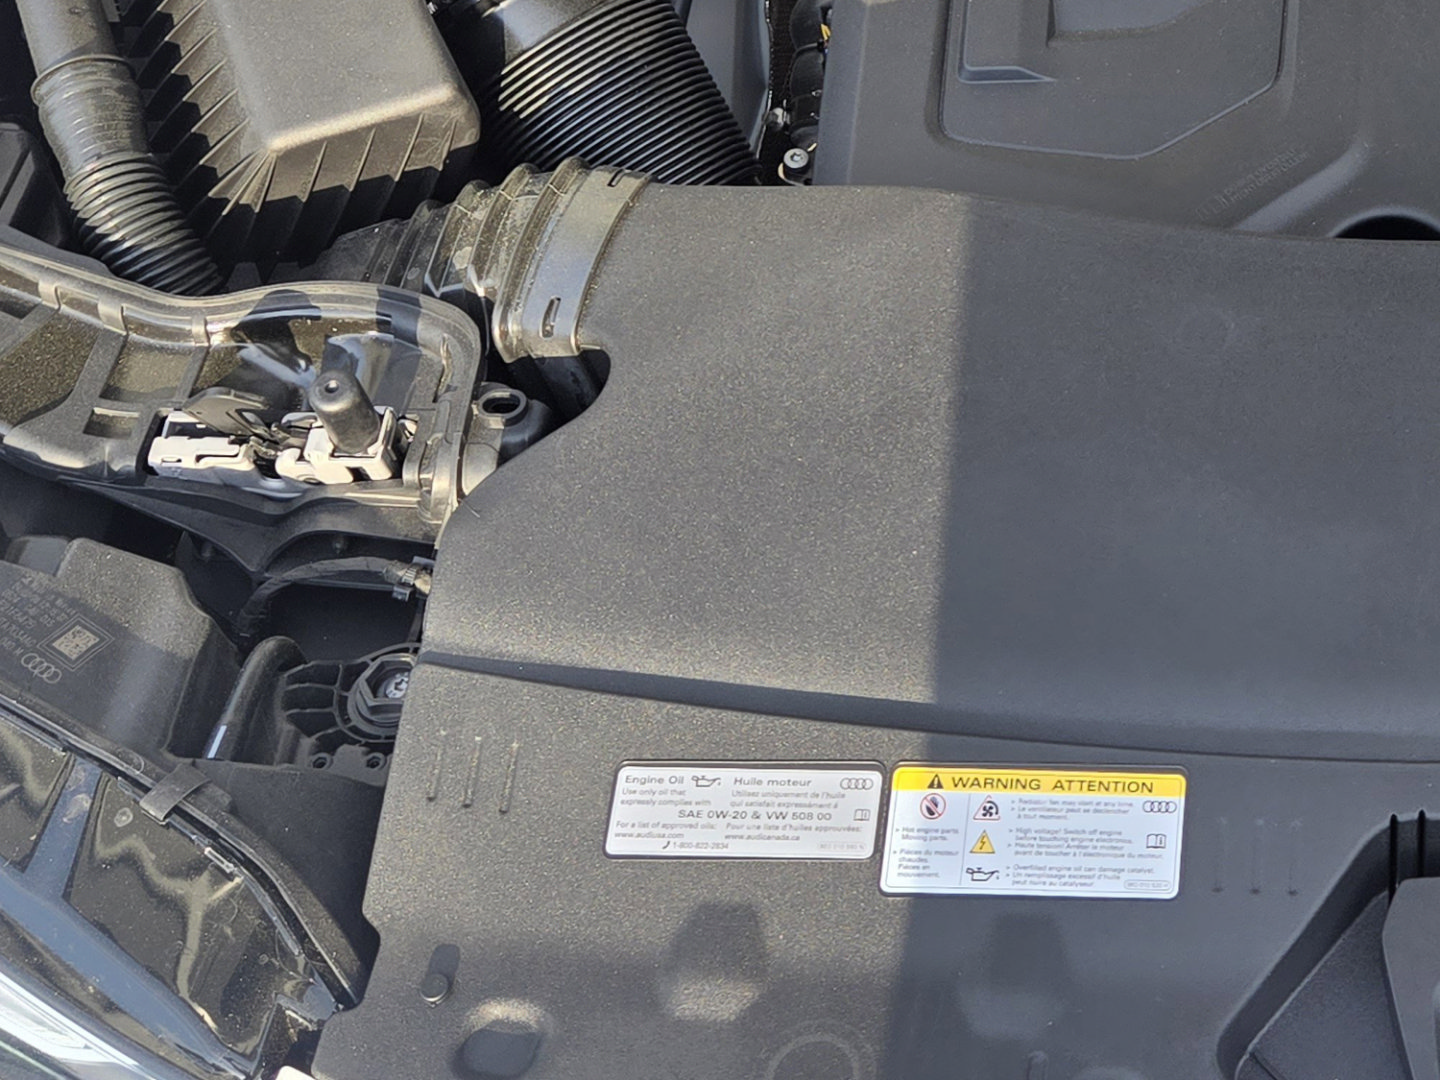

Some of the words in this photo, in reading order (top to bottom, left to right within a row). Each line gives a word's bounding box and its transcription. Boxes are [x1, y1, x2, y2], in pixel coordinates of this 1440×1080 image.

[625, 775, 665, 786] Engine
[668, 775, 684, 785] Oil
[733, 777, 764, 787] Huile
[767, 777, 812, 787] moteur
[952, 776, 1042, 789] WARNING
[1052, 779, 1154, 793] ATTENTION
[622, 788, 638, 796] Use
[641, 788, 659, 798] only
[661, 788, 670, 797] oil
[762, 790, 808, 801] uniquement
[811, 790, 820, 799] de
[658, 798, 693, 808] complies
[695, 798, 712, 807] with
[678, 810, 704, 819] SAE
[707, 810, 748, 820] 0W-20
[751, 810, 762, 820] &
[766, 811, 789, 821] VW
[792, 811, 814, 821] 508
[817, 811, 832, 821] 00
[616, 821, 630, 829] For
[638, 821, 650, 830] list
[651, 821, 660, 830] of
[661, 821, 699, 832] approved
[726, 822, 746, 831] Pour
